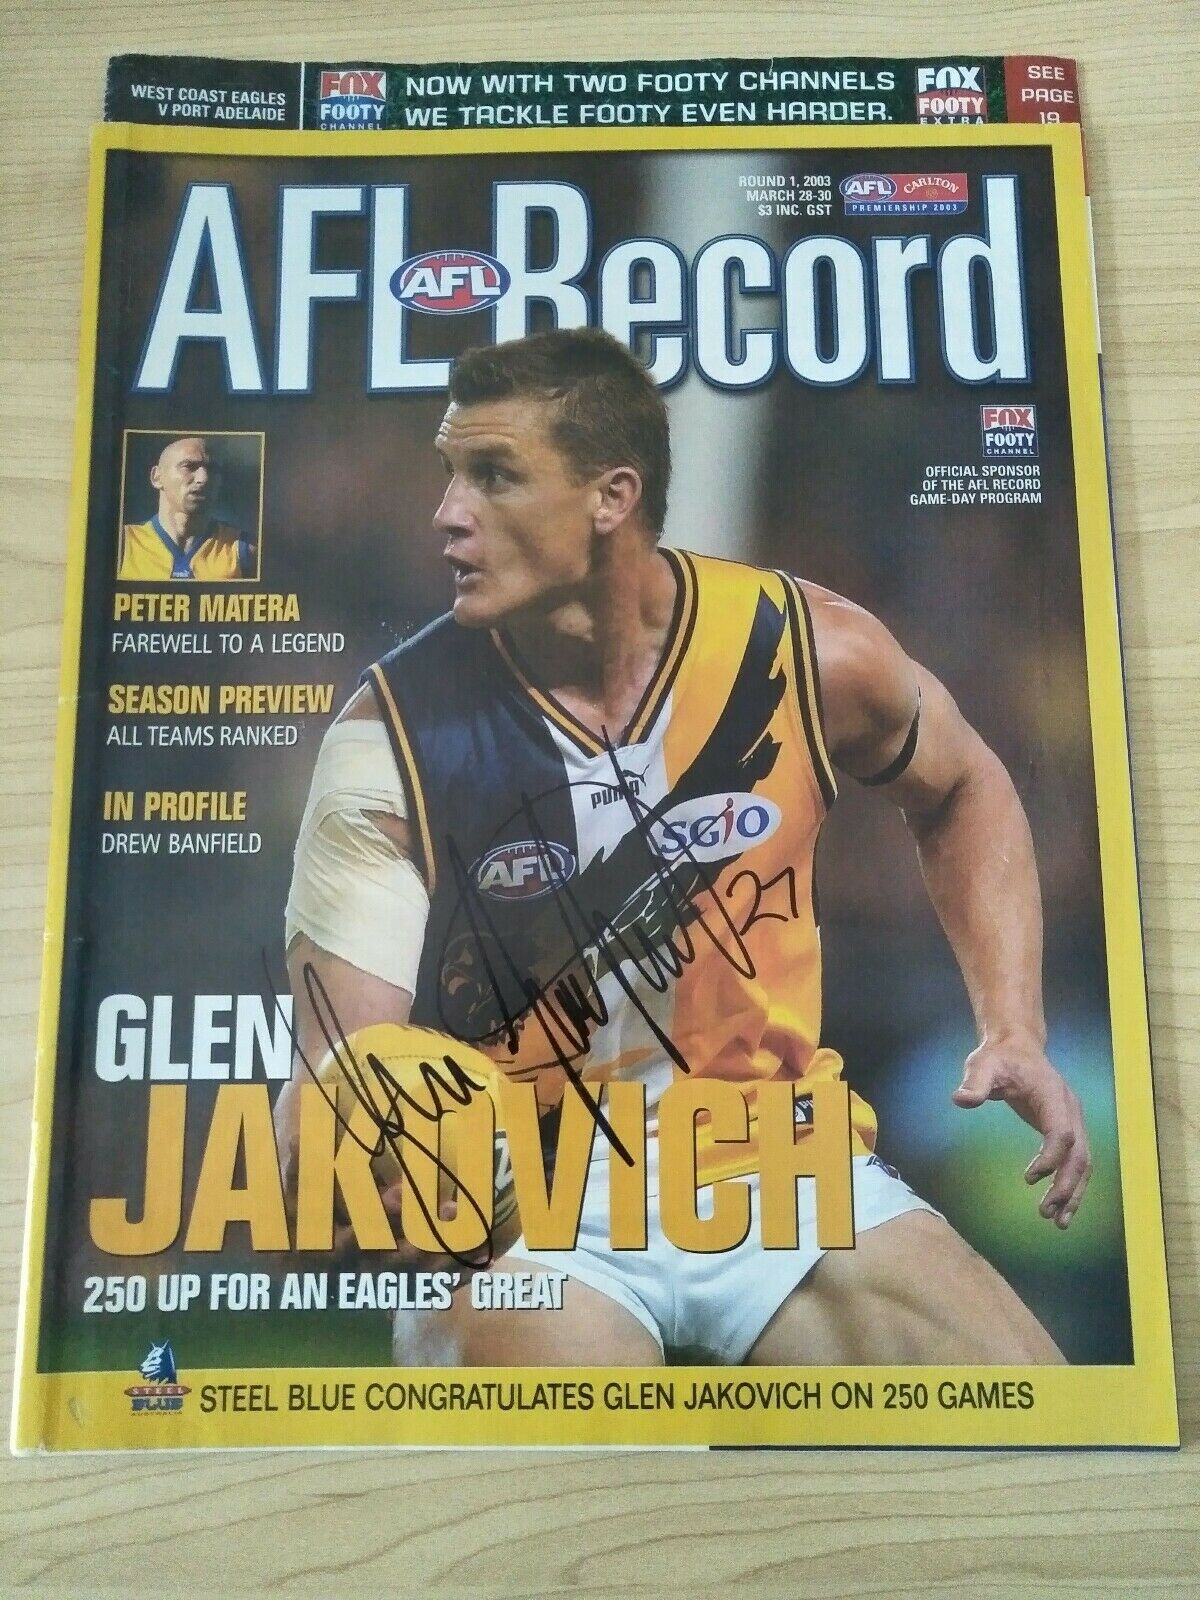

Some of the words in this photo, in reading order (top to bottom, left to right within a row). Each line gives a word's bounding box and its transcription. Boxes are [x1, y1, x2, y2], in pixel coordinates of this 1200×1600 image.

[917, 66, 983, 93] FOX
[1027, 65, 1065, 81] SEE
[321, 72, 385, 99] FOX
[406, 76, 472, 96] NOW
[482, 74, 553, 94] WITH
[564, 74, 626, 92] TWO
[637, 72, 729, 93] FOOTY
[739, 71, 895, 91] CHANNELS
[131, 84, 174, 100] WEST
[178, 88, 227, 103] COAST
[231, 91, 286, 106] EAGLES
[1021, 88, 1075, 104] PAGE
[158, 103, 168, 116] V
[172, 104, 210, 118] PORT
[214, 105, 286, 121] ADELAIDE
[320, 104, 385, 121] FOOTY
[405, 107, 448, 126] WE
[459, 104, 569, 125] TACKLE
[580, 104, 671, 124] FOOTY
[682, 102, 756, 123] EVEN
[768, 101, 893, 122] HARDER.
[919, 97, 984, 115] FOOTY
[320, 122, 382, 131] CHANNEL
[920, 116, 984, 125] EXTRA
[1040, 111, 1061, 124] 19
[739, 175, 786, 187] ROUND
[789, 176, 800, 189] 1,
[803, 175, 831, 187] 2003
[845, 180, 892, 196] AFL
[903, 177, 960, 194] CARLTON
[746, 190, 795, 202] MARCH
[798, 189, 832, 201] 28-30
[758, 204, 773, 216] $3
[776, 204, 803, 216] INC.
[806, 204, 832, 216] GST
[852, 204, 928, 212] PREMIERSHIP
[933, 204, 958, 212] 2003
[131, 181, 454, 395] AFL
[492, 174, 1032, 389] Record
[399, 265, 500, 300] AFL
[983, 408, 1035, 430] FOX
[985, 432, 1035, 447] FOOTY
[925, 465, 978, 478] OFFICIAL
[982, 465, 1041, 477] SPONSOR
[922, 479, 938, 491] OF
[941, 479, 964, 491] THE
[968, 479, 989, 490] AFL
[993, 478, 1041, 490] RECORD
[910, 493, 976, 506] GAME-DAY
[980, 493, 1042, 504] PROGRAM
[113, 592, 191, 622] PETER
[199, 593, 301, 622] MATERA
[112, 632, 212, 653] FAREWELL
[219, 633, 243, 653] TO
[250, 633, 264, 653] A
[272, 632, 345, 653] LEGEND
[108, 684, 211, 715] SEASON
[219, 684, 334, 714] PREVIEW
[106, 725, 142, 746] ALL
[149, 725, 215, 746] TEAMS
[220, 725, 298, 746] RANKED
[103, 791, 134, 821] IN
[144, 791, 248, 821] PROFILE
[101, 832, 161, 854] DREW
[169, 832, 262, 854] BANFIELD
[95, 994, 294, 1082] GLEN
[89, 1079, 856, 1257] JAKOVICH
[83, 1275, 146, 1313] 250
[157, 1274, 201, 1312] UP
[209, 1273, 271, 1311] FOR
[280, 1272, 328, 1311] AN
[471, 1271, 569, 1311] GREAT
[132, 1387, 184, 1395] STEEL
[200, 1384, 278, 1412] STEEL
[288, 1383, 356, 1411] BLUE
[365, 1382, 594, 1411] CONGRATULATES
[604, 1382, 675, 1410] GLEN
[685, 1382, 821, 1410] JAKOVICH
[831, 1381, 873, 1410] ON
[882, 1382, 929, 1410] 250
[938, 1381, 1035, 1410] GAMES
